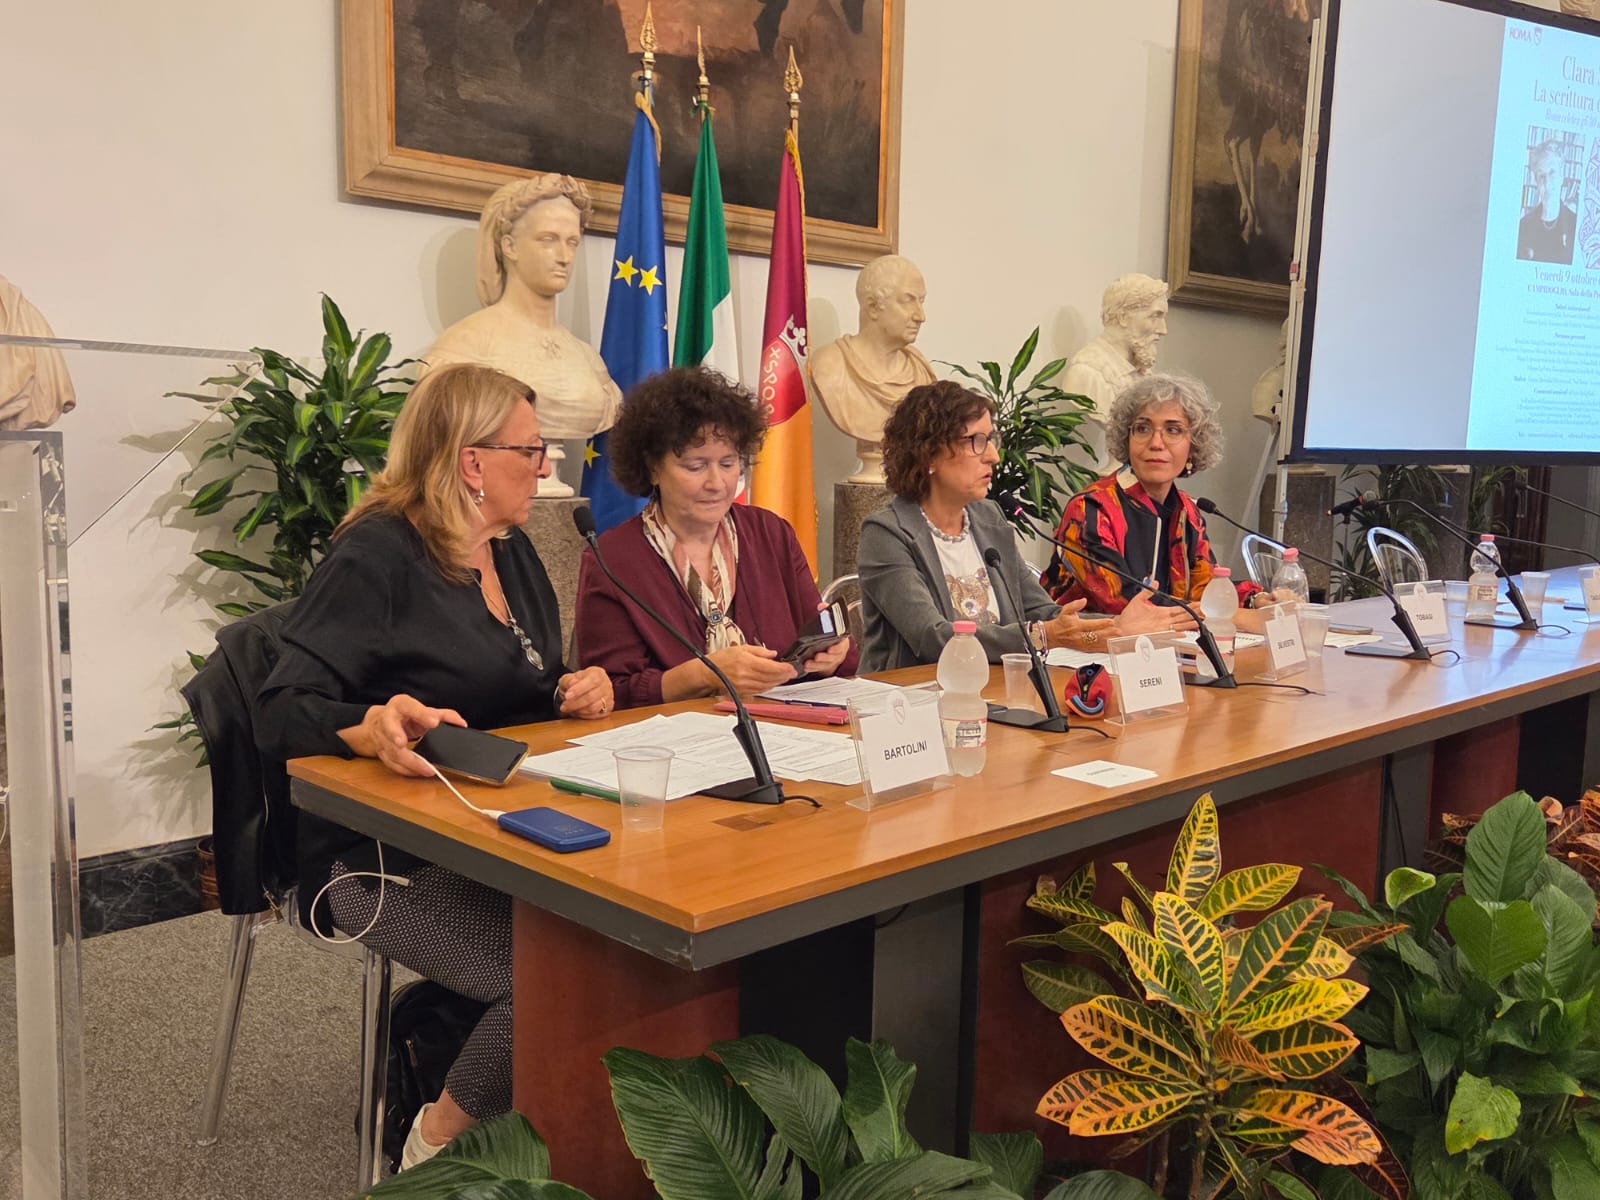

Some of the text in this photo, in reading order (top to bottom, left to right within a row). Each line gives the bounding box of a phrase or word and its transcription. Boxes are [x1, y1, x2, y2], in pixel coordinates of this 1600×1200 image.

[1562, 55, 1595, 85] Clara
[1534, 80, 1546, 104] La
[1549, 86, 1594, 111] scrittura
[1139, 678, 1163, 689] SERENI
[884, 740, 928, 760] BARTOLINI
